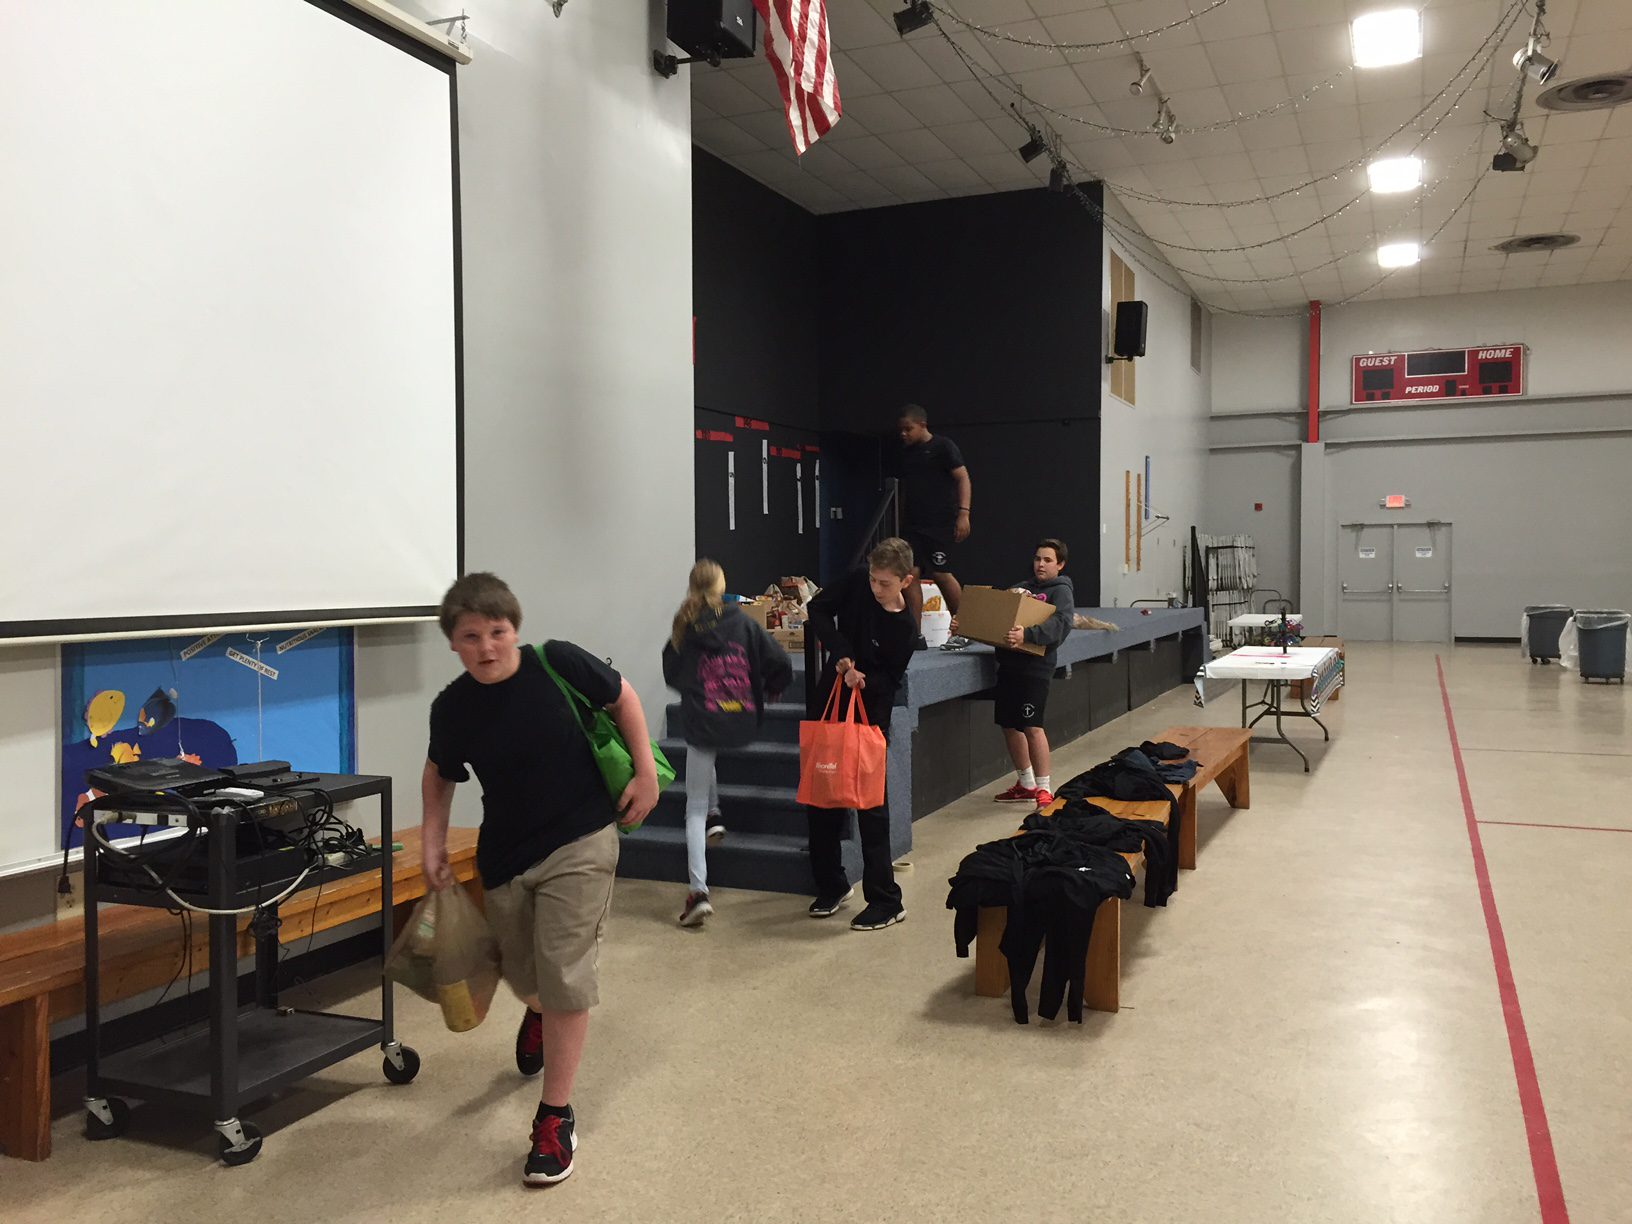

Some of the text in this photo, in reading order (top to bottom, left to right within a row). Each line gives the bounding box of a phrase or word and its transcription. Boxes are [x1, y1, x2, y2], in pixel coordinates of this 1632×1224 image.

[1478, 348, 1514, 360] HOME
[1359, 356, 1397, 367] GUEST
[1405, 385, 1440, 394] PERIOD
[228, 650, 240, 660] GET
[239, 655, 259, 669] PLENTY
[264, 667, 277, 678] REST
